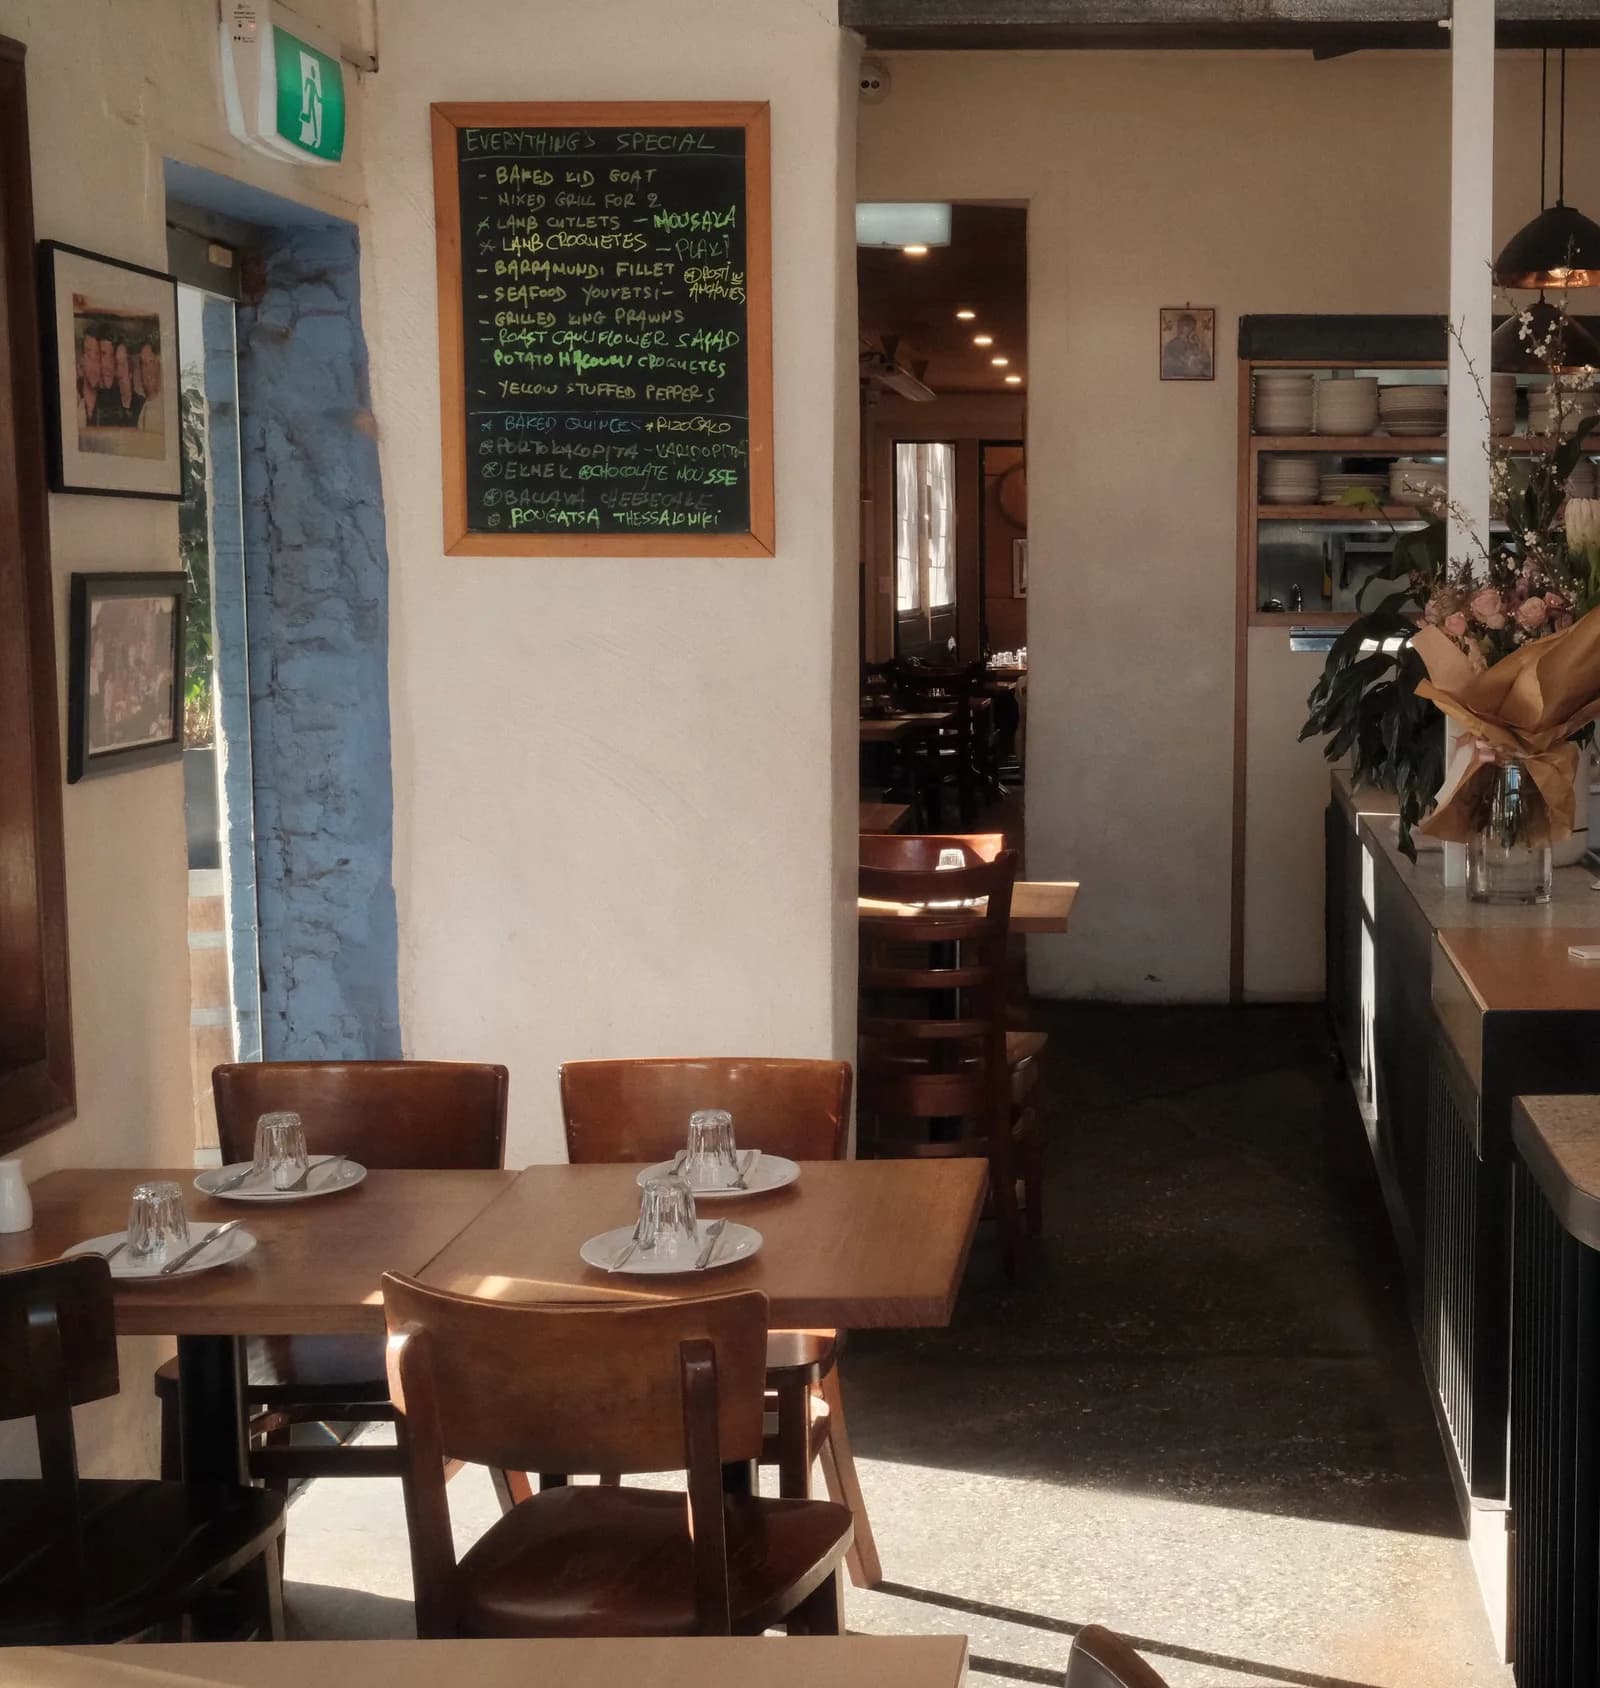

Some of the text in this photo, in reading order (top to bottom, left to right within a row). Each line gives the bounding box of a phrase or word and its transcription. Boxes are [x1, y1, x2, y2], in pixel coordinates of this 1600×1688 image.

[616, 132, 715, 152] SPECIAL
[496, 164, 656, 191] BAKED KID GOAT
[498, 191, 662, 212] MIXED GRILL FOR 2
[497, 213, 620, 234] LAMB CUTLETS
[653, 204, 736, 233] MOUSAKA
[502, 231, 647, 257] LAMB CROQUETES
[494, 260, 675, 281] BARRAMUNDI FILLET
[494, 285, 567, 309] SEAFOOD
[495, 307, 685, 331] GRILLED KING PRAWNS
[499, 327, 740, 353] ROAST CAULIFLOWER SALAD
[493, 348, 554, 371] POTATO
[637, 353, 726, 379] CROQUETES
[498, 380, 716, 403] YELLOW STUFFED PEPPERS
[505, 415, 557, 434] BAKED
[504, 461, 573, 480] EKMEK
[590, 462, 738, 491] CHOCOLATE MOUSSE
[510, 507, 600, 529] BOUGATSA
